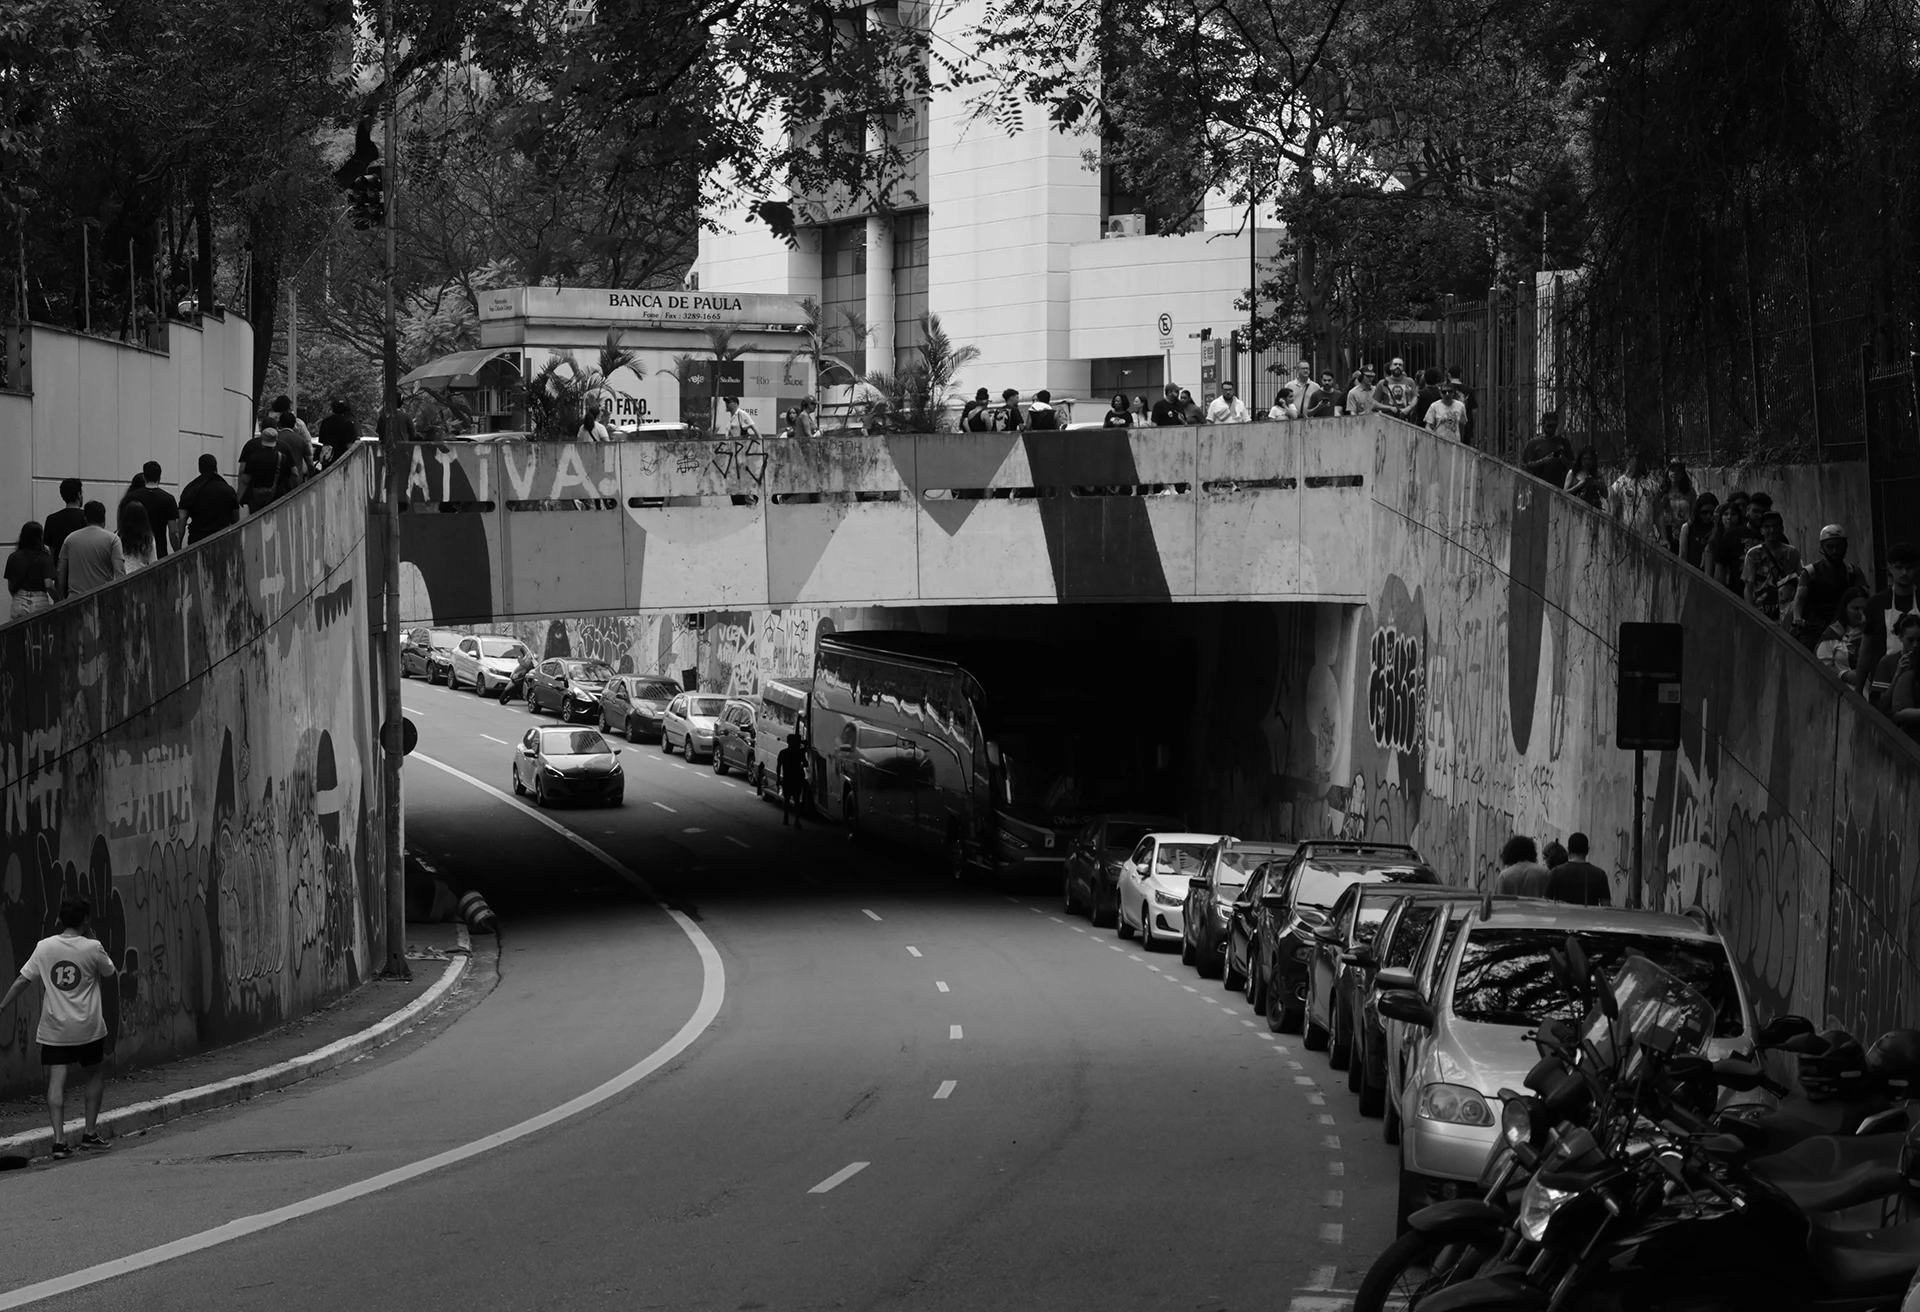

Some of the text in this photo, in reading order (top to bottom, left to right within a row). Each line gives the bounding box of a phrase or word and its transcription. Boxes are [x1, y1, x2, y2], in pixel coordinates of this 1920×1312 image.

[609, 294, 742, 310] BANCA DE PAULA
[756, 376, 770, 385] Rio
[616, 398, 651, 415] FATO.
[55, 965, 76, 985] 13
